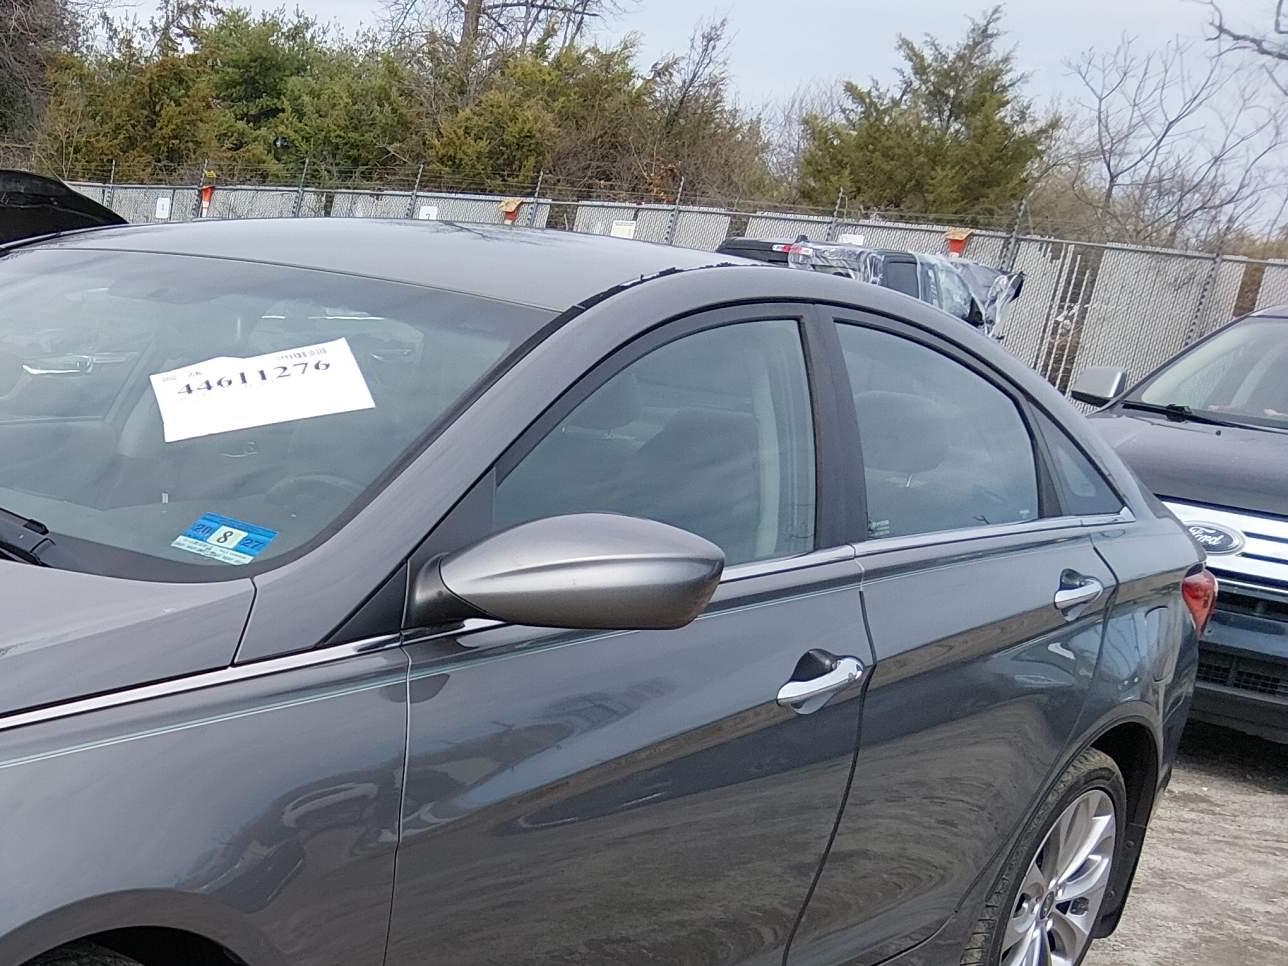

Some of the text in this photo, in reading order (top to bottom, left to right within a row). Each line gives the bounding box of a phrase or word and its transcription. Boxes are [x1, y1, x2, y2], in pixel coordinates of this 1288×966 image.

[177, 360, 331, 395] 44611276
[216, 530, 234, 544] 8
[1189, 526, 1225, 546] Ford
